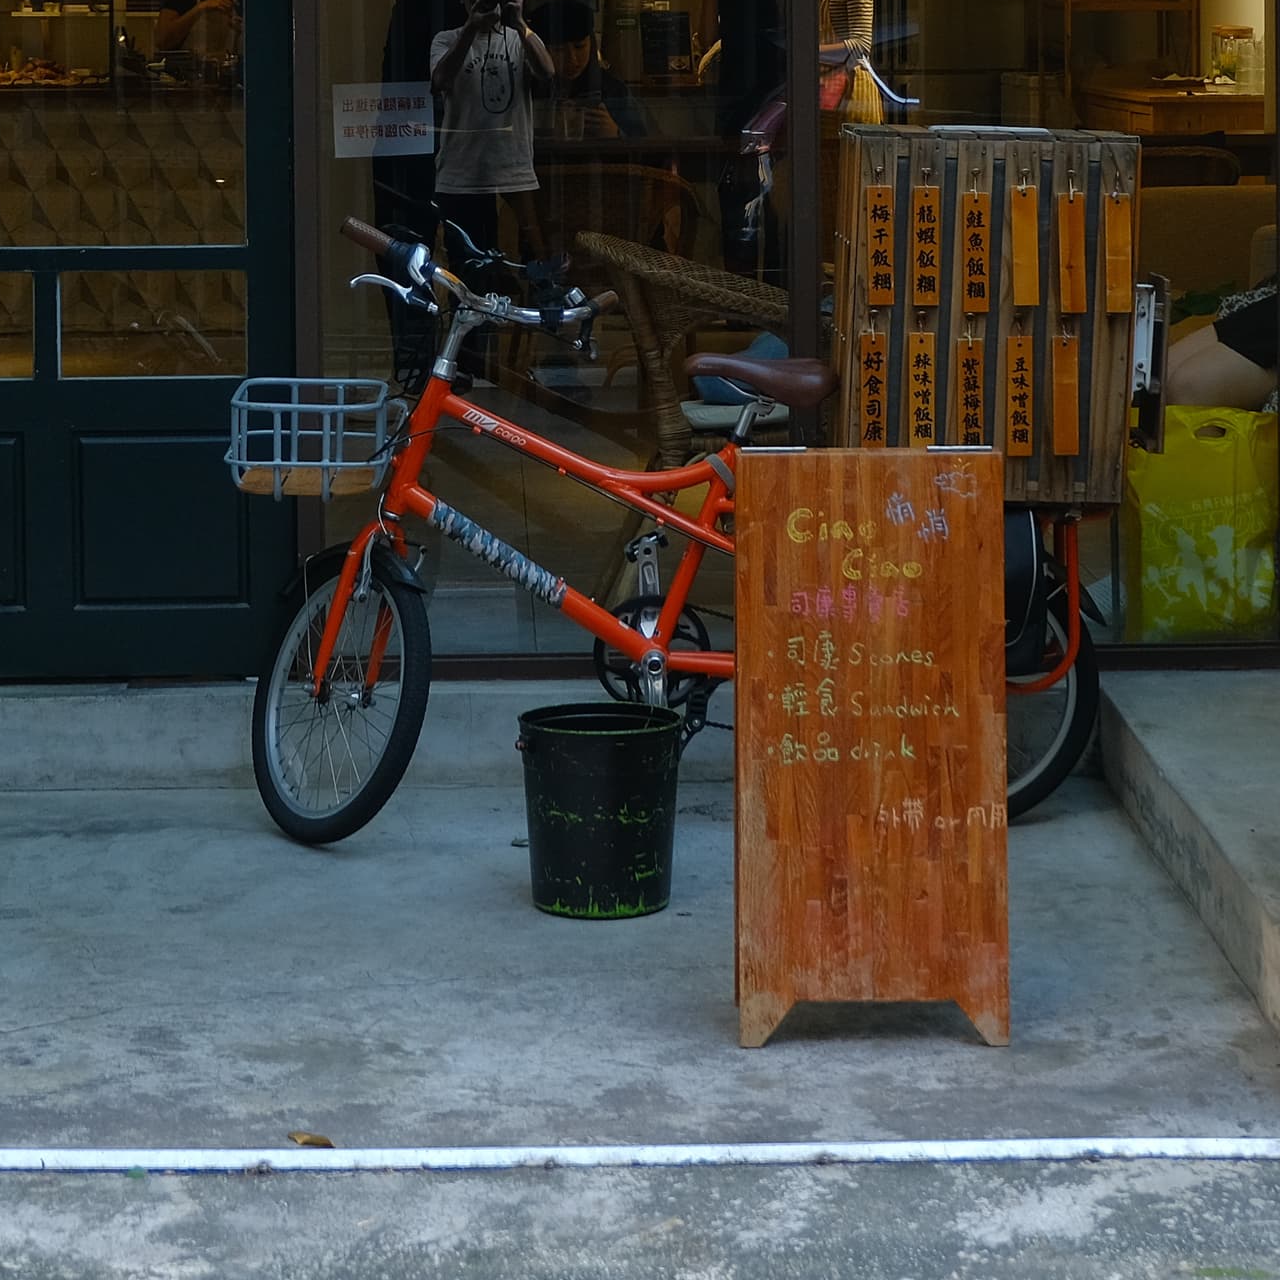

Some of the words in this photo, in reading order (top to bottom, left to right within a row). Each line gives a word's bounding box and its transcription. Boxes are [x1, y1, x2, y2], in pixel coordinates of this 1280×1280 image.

[870, 204, 891, 290] 梅干飯糰
[916, 205, 937, 293] 龍蝦飯糰
[966, 210, 986, 298] 鮭魚飯糰
[863, 351, 883, 441] 好食司康
[913, 352, 932, 439] 辣味噌飯糰
[1011, 357, 1030, 444] 豆味噌飯糰
[786, 507, 877, 544] Ciao
[842, 548, 923, 581] Ciao
[787, 630, 840, 670] 司康
[848, 642, 936, 667] Scones
[781, 677, 837, 717] 輕食
[850, 690, 960, 718] Sandwich
[779, 731, 841, 766] 飲品
[850, 732, 917, 761] drink
[934, 815, 960, 830] or
